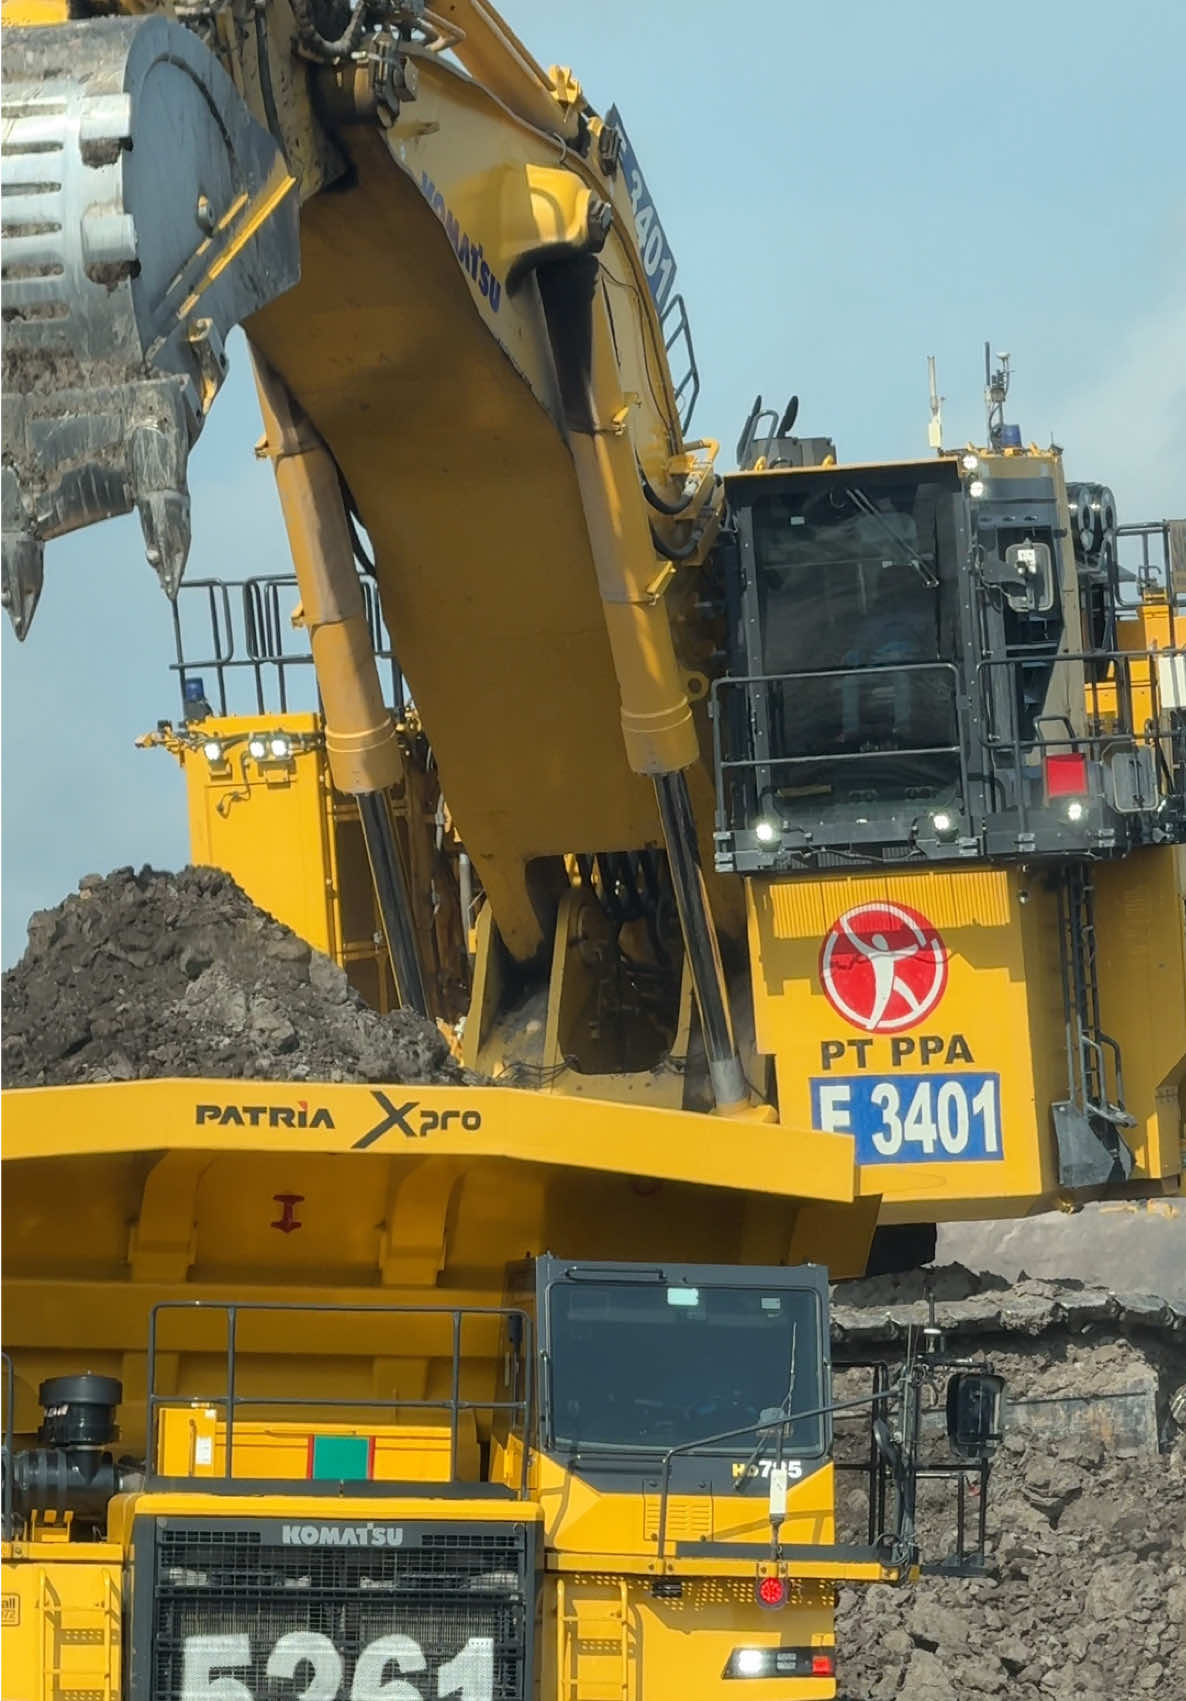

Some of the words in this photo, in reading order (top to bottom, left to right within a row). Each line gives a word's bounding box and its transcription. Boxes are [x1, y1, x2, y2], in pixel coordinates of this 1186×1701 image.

[421, 170, 501, 313] KOMATSU
[821, 1039, 873, 1070] PT
[891, 1034, 975, 1066] PPA
[196, 1101, 336, 1129] PATRIA
[871, 1080, 998, 1155] 3401
[282, 1523, 404, 1546] KOMATSU
